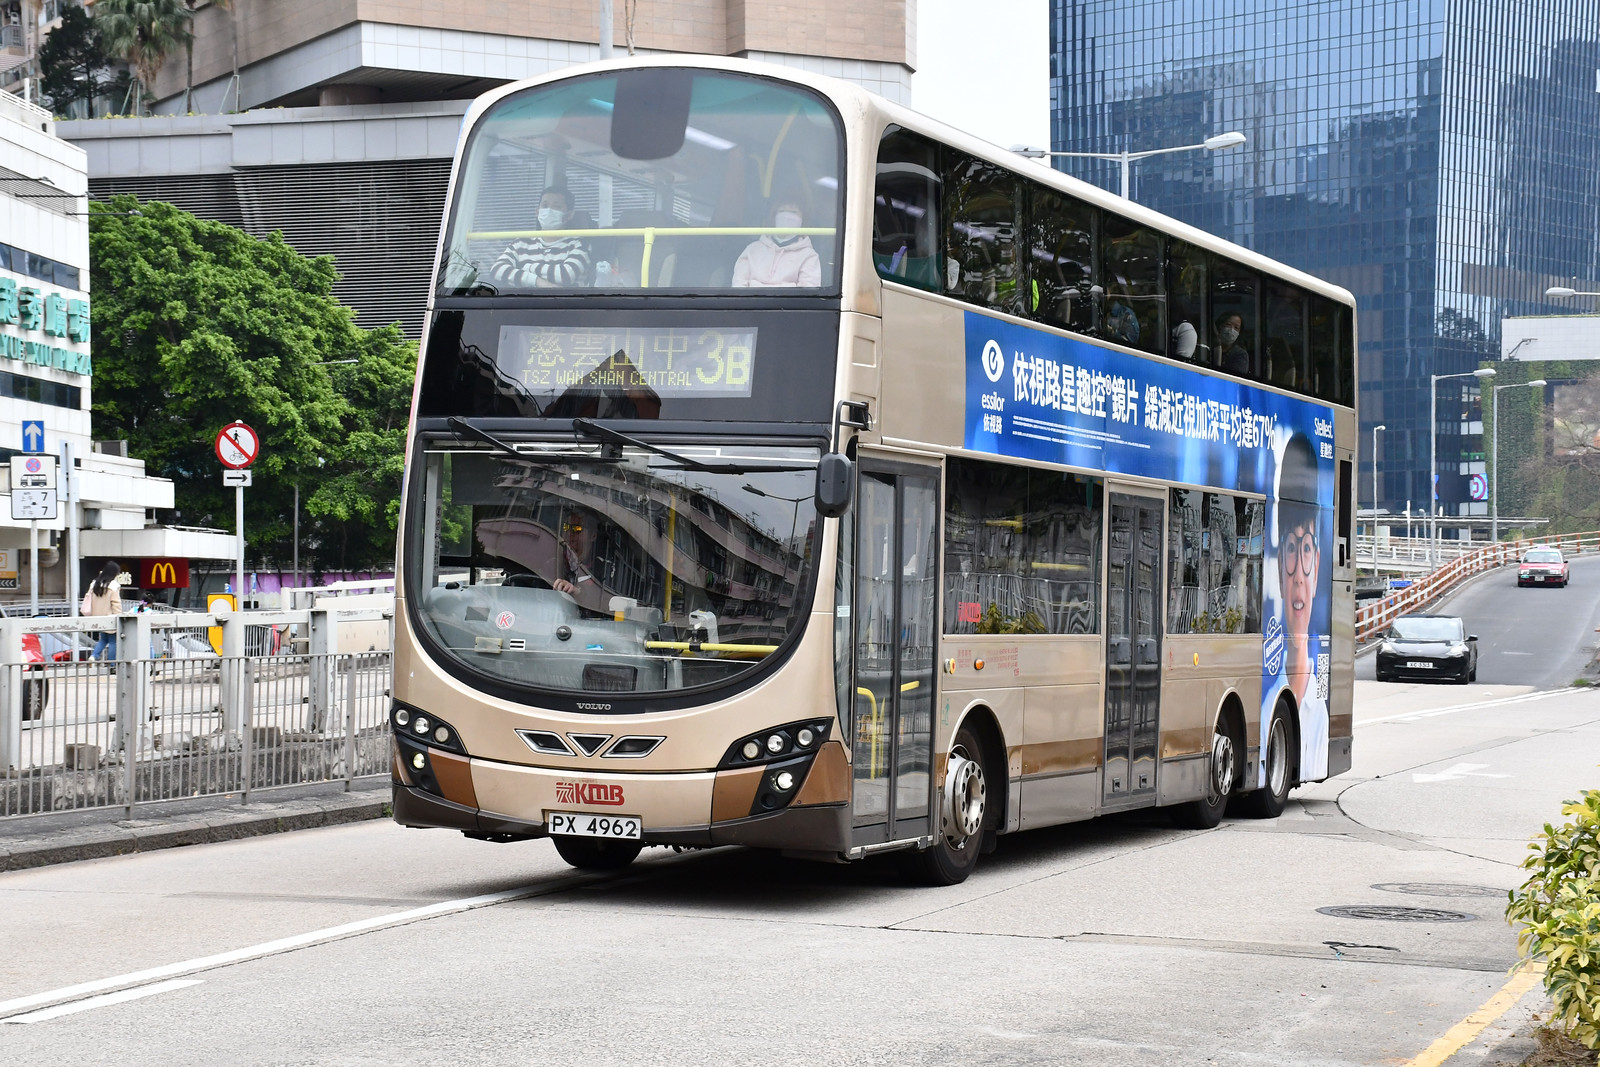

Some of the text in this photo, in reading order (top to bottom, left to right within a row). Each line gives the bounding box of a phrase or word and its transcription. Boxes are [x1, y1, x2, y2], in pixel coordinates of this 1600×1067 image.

[25, 342, 52, 367] XIU
[527, 329, 688, 370] 慈雲山中
[696, 330, 750, 386] 3B
[522, 369, 692, 387] TSZ WAN SHAN CENTRAL
[981, 391, 1006, 412] essilor
[41, 491, 48, 501] 7
[41, 506, 48, 516] 7
[576, 702, 612, 711] VOLVO
[575, 783, 625, 806] KMB
[552, 815, 637, 838] PX 4962
